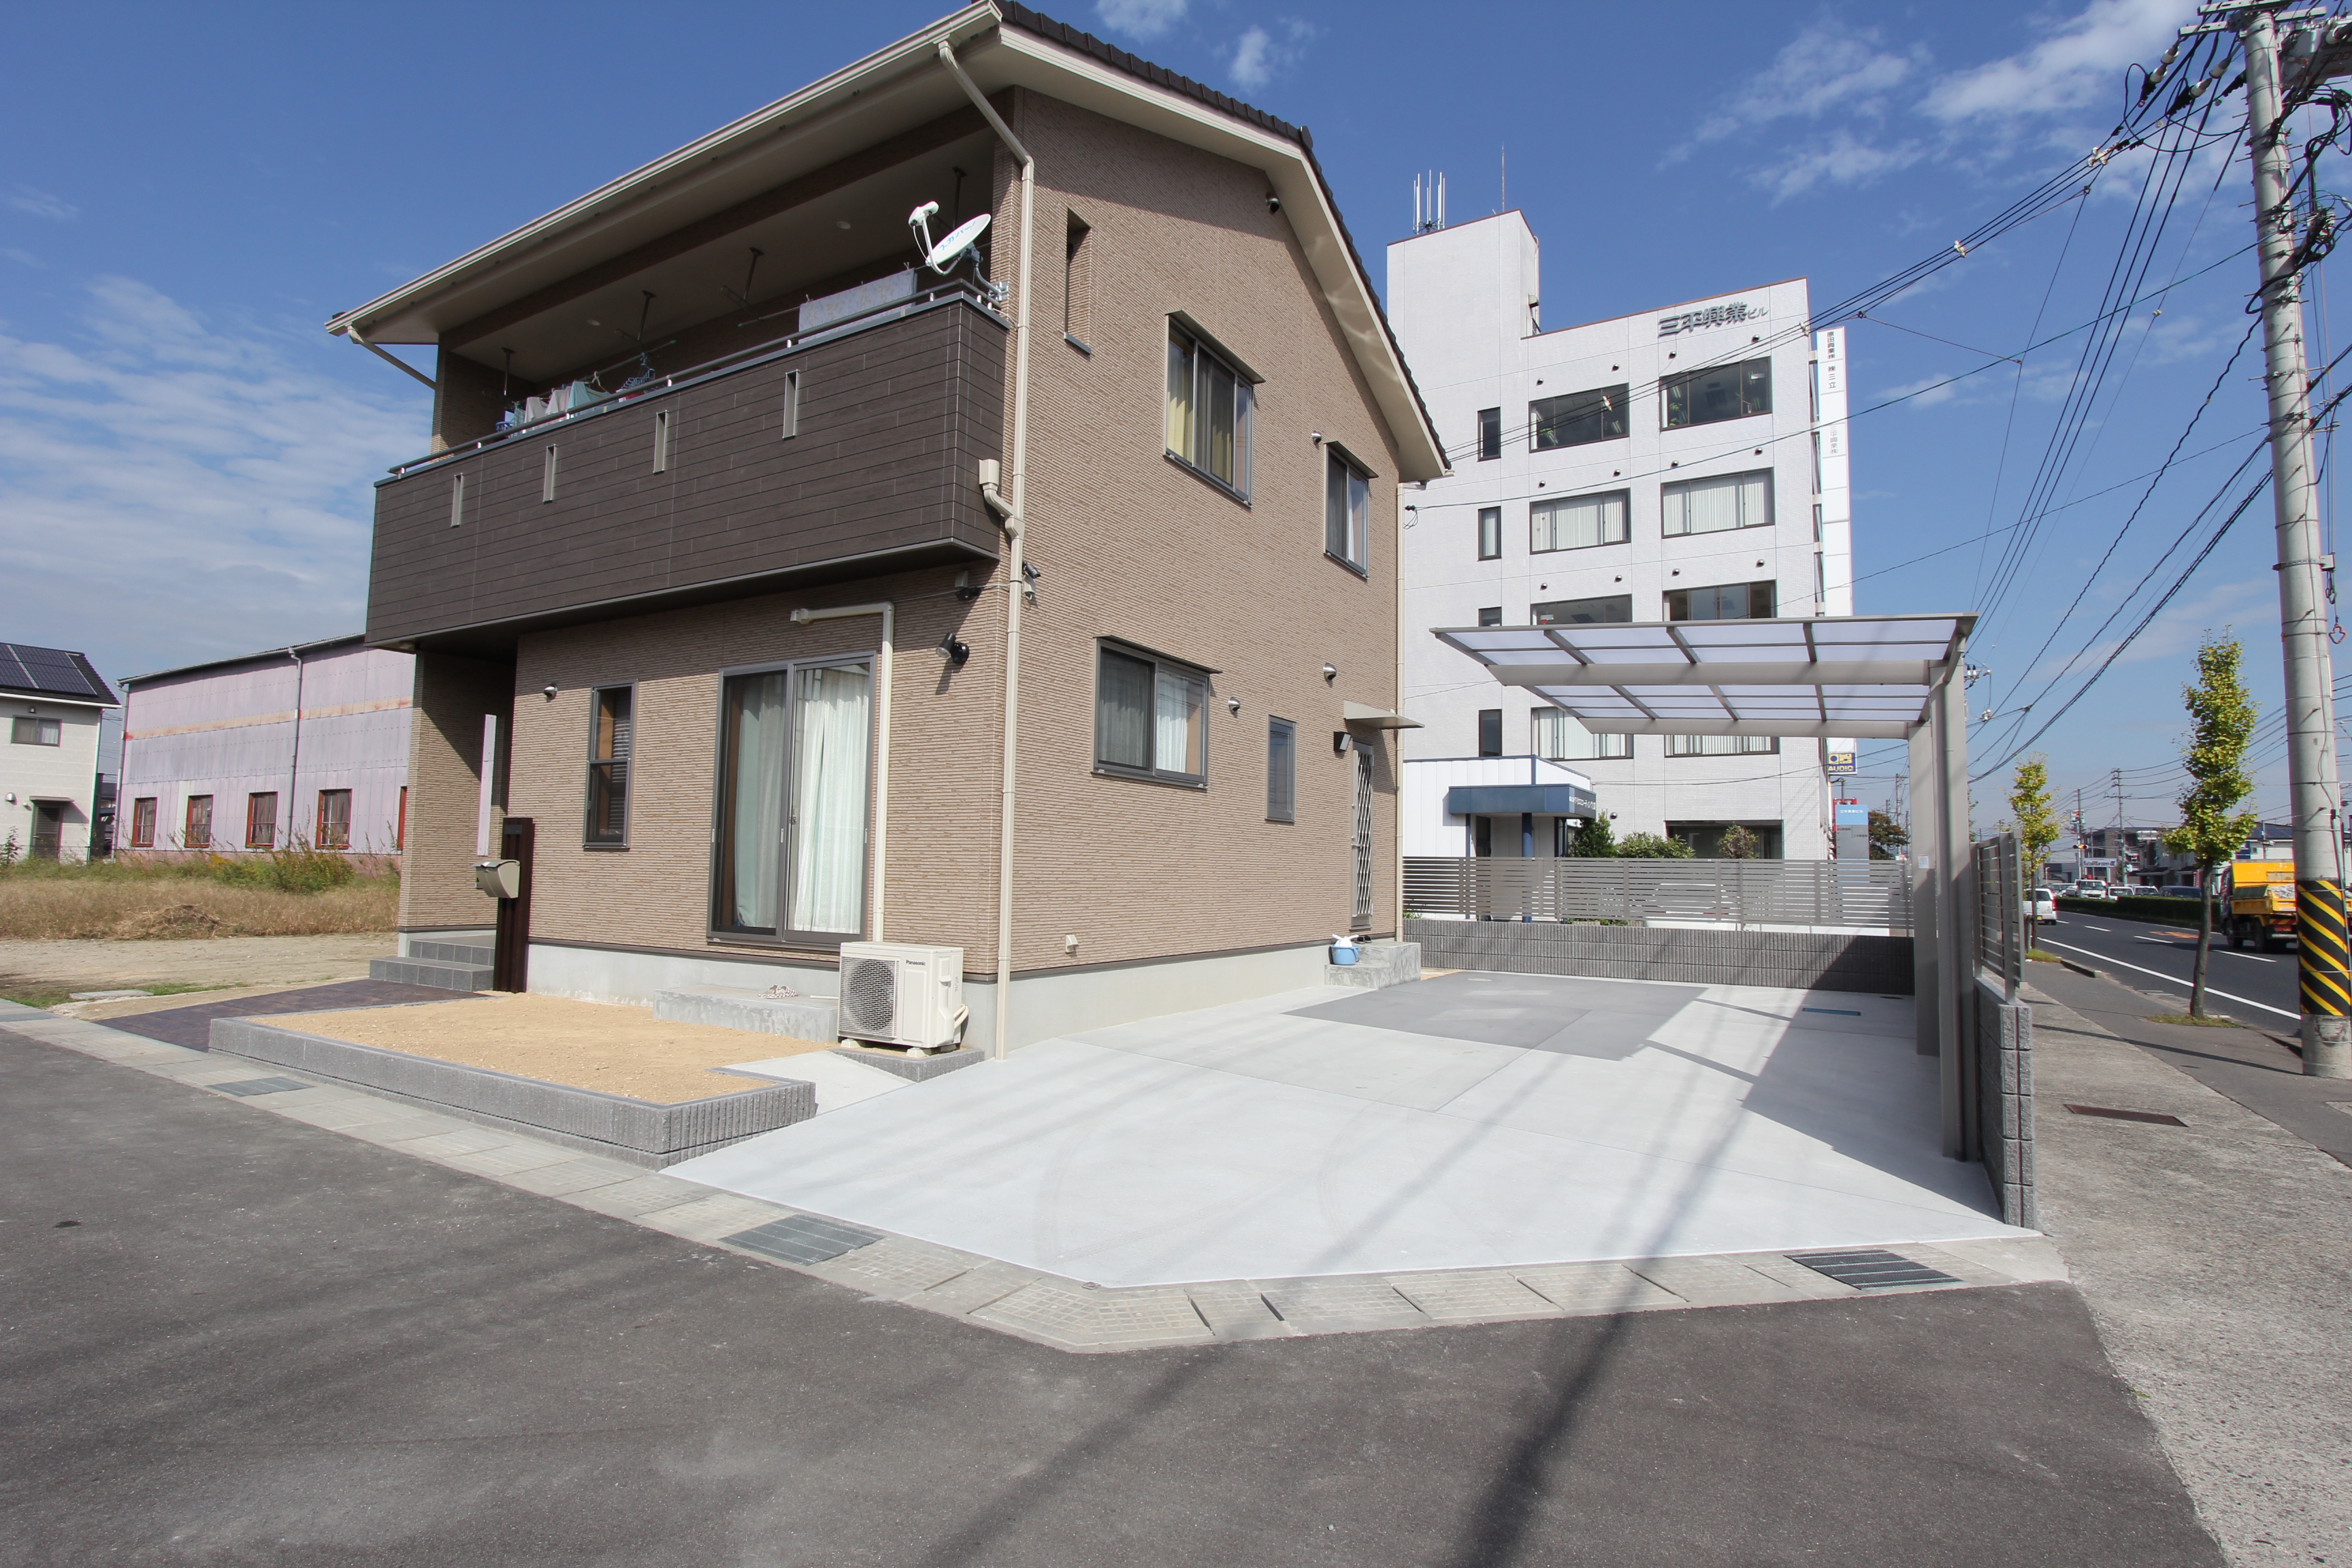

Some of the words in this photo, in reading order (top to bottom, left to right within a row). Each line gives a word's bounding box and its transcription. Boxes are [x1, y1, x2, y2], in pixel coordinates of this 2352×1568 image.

[1659, 301, 1769, 337] 三平興業ビル
